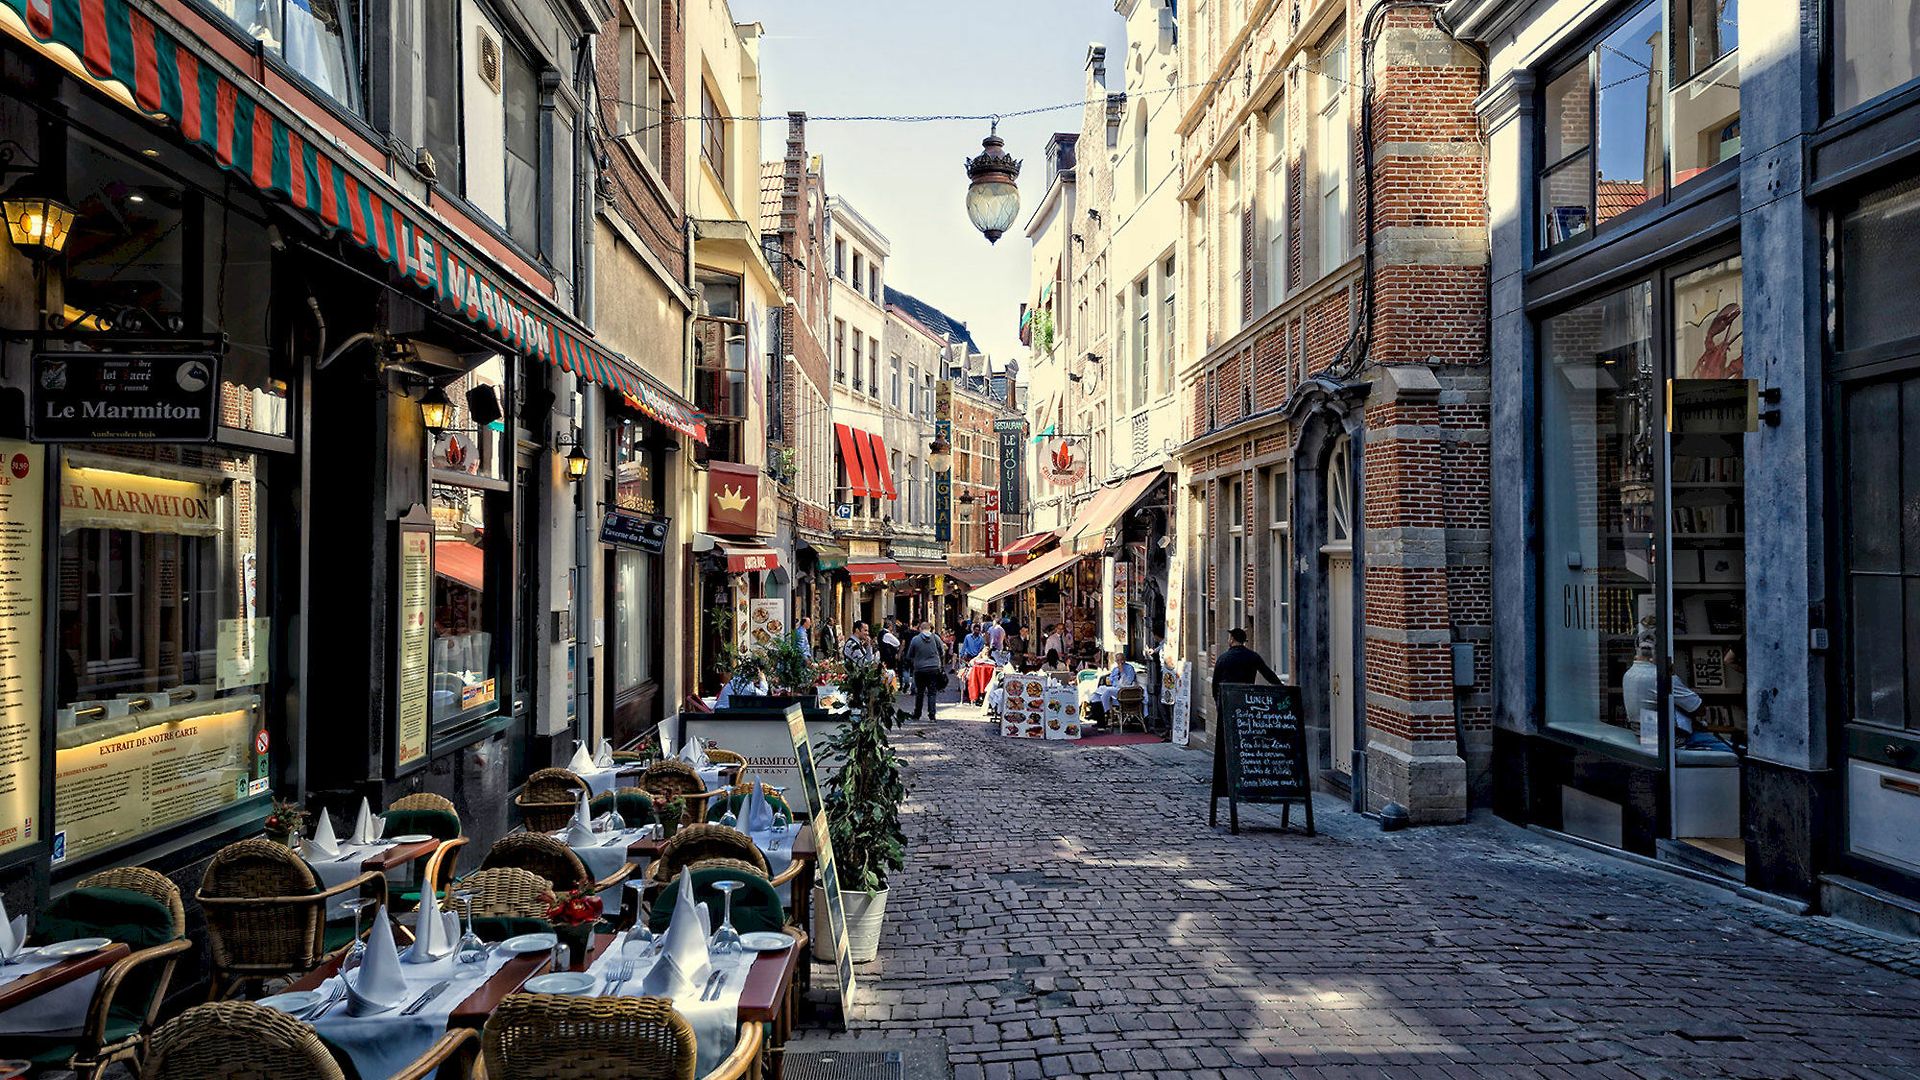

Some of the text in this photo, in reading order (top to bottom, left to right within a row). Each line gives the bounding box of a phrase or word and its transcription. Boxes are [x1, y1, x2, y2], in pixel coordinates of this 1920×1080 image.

[402, 223, 550, 354] LE MARMITON
[46, 401, 200, 419] Le Marmiton
[1003, 434, 1017, 512] LE MOULIN
[61, 484, 210, 519] LE MARMITON
[1696, 657, 1706, 686] LES
[1708, 650, 1723, 686] UNES
[1245, 694, 1273, 705] LUNCH
[99, 726, 198, 756] EXTRAIT DE NOTRE CARTE
[745, 756, 797, 766] MARMITO
